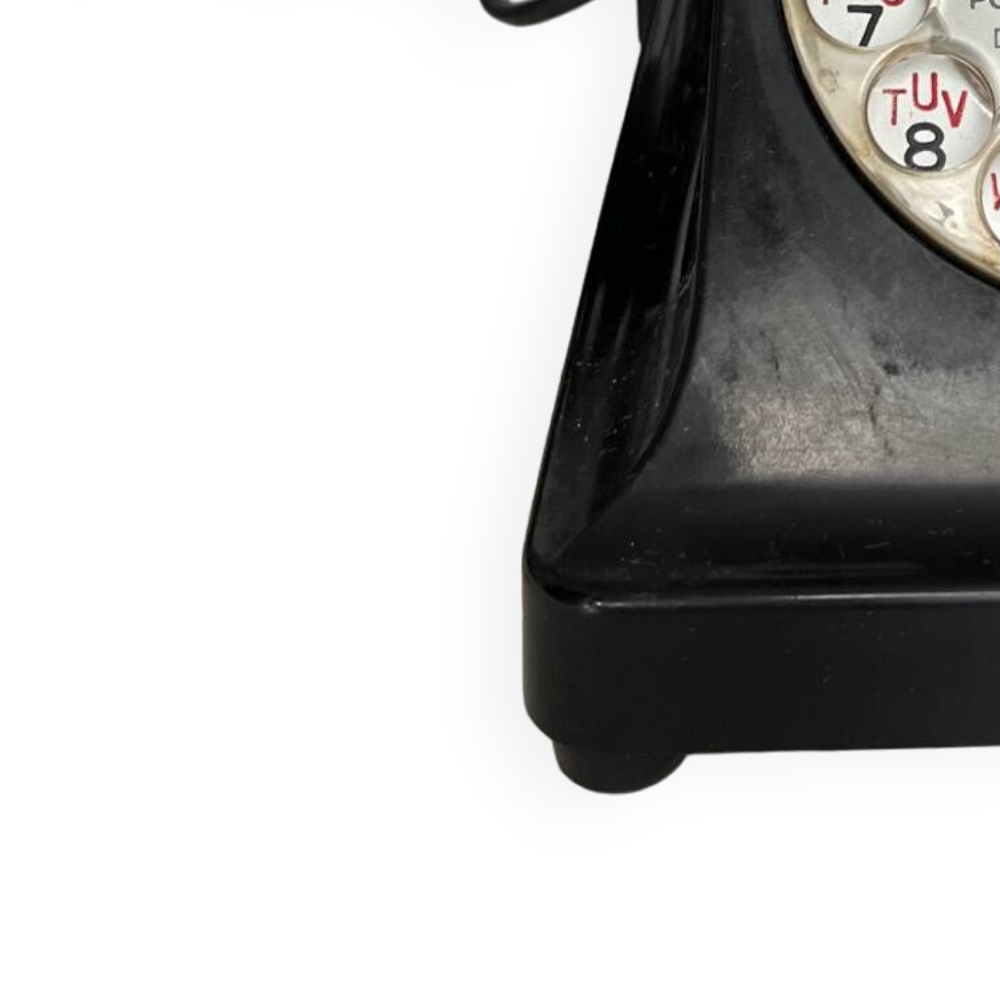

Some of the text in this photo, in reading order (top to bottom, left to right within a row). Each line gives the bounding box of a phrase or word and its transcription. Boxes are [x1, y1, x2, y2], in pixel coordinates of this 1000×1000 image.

[847, 4, 884, 48] 7
[883, 72, 968, 128] TUV
[903, 121, 947, 172] 8
